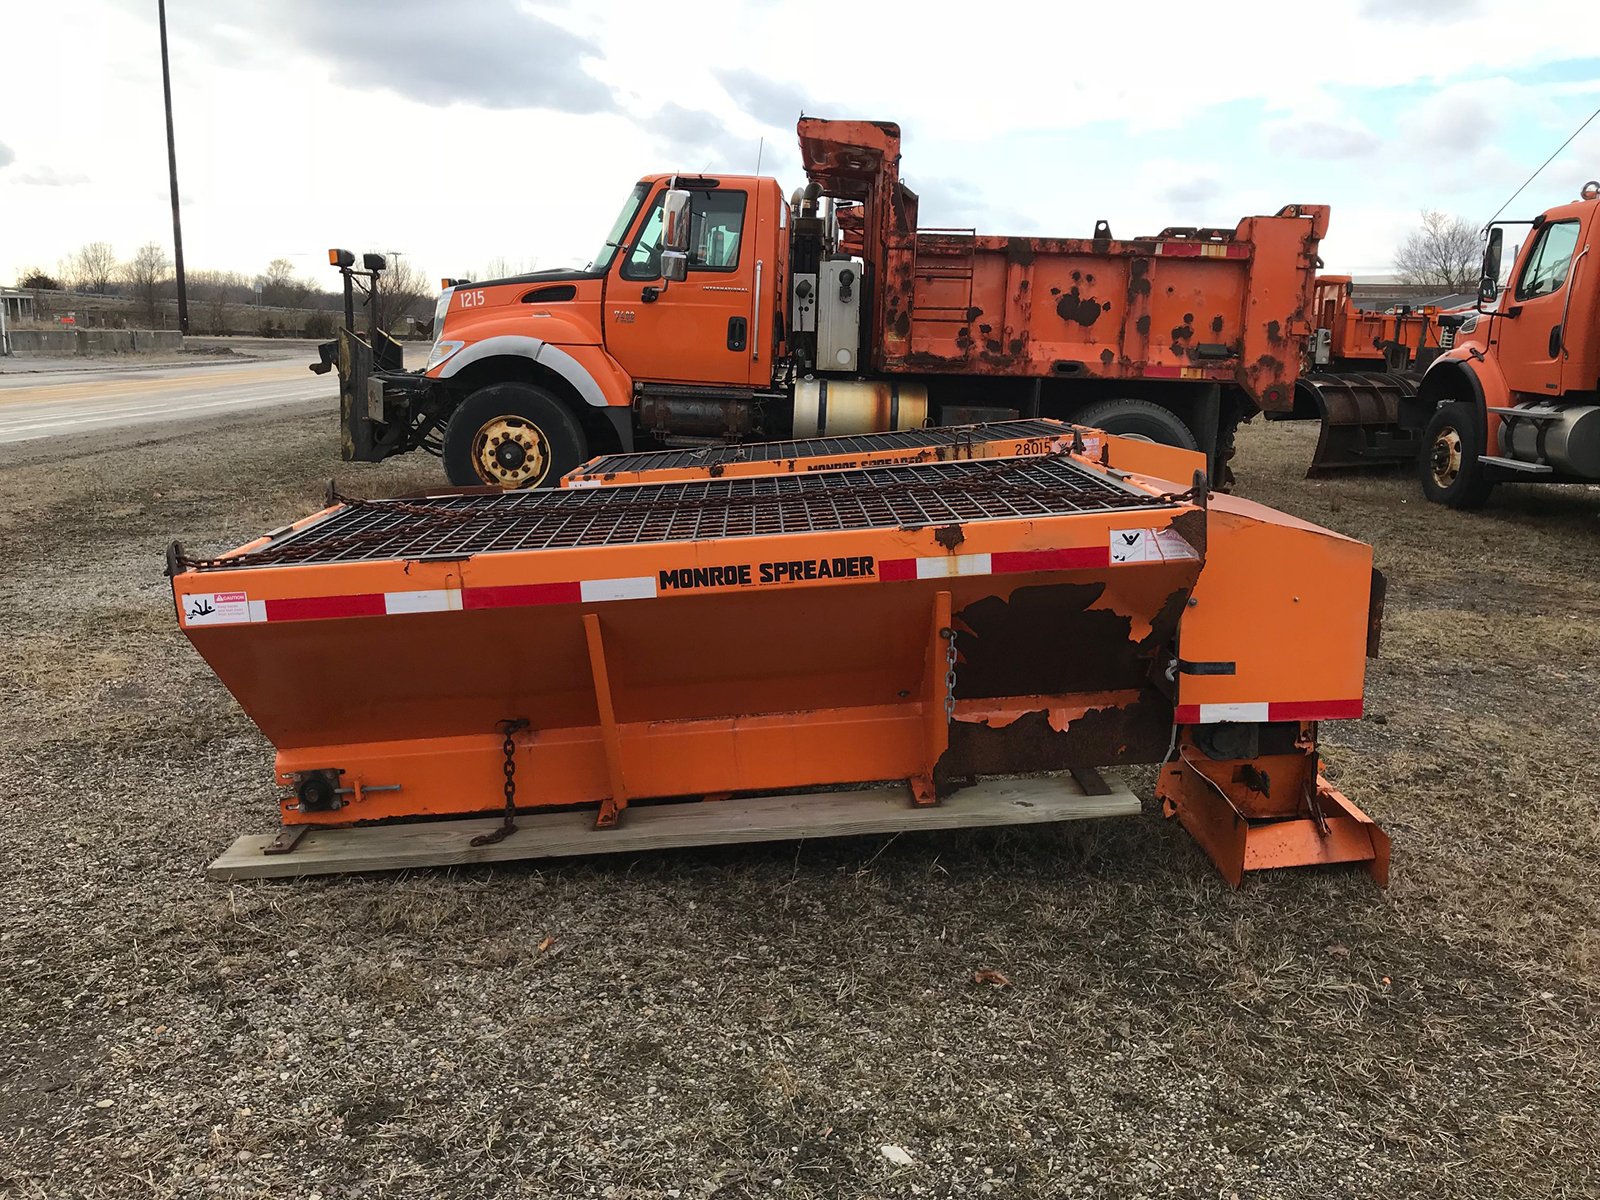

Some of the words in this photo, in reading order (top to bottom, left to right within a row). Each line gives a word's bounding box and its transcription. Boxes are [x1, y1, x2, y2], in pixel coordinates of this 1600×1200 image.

[460, 290, 485, 308] 1215
[1015, 441, 1051, 456] 28015
[659, 565, 752, 590] MONROE
[759, 556, 875, 583] SPREADER
